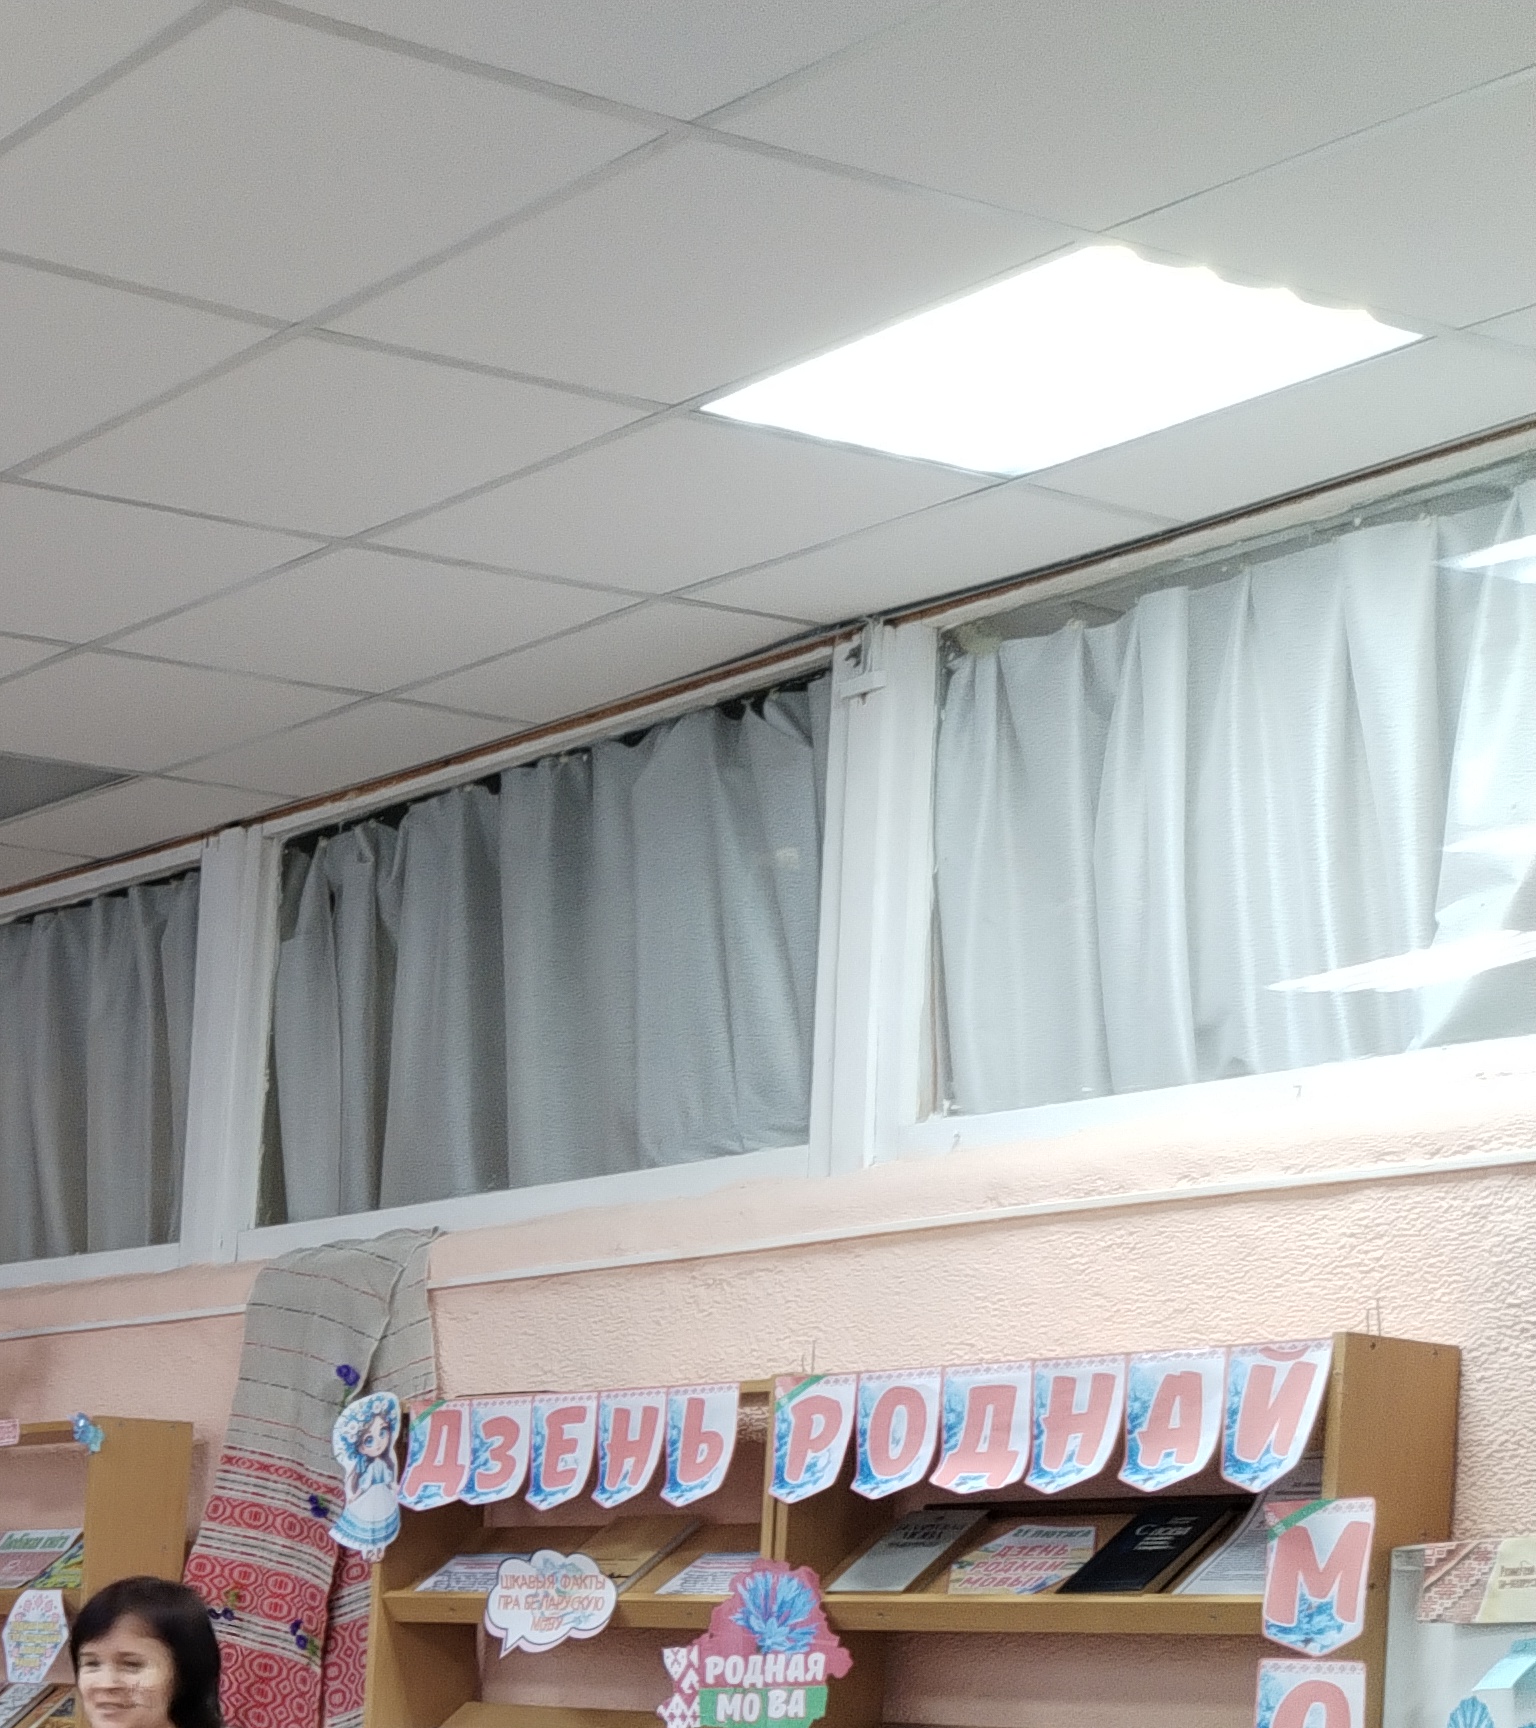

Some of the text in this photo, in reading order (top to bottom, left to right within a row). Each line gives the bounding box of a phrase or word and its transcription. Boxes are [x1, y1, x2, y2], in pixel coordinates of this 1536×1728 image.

[403, 1346, 1318, 1498] ДЗЕНЬ РОДНАЙ
[991, 1544, 1069, 1558] ДЗЕНЬ
[560, 1573, 606, 1590] ФАКТЫ
[497, 1594, 605, 1611] ПРА БЕЛАРУСКУЮ
[704, 1652, 827, 1688] РОДНАЯ
